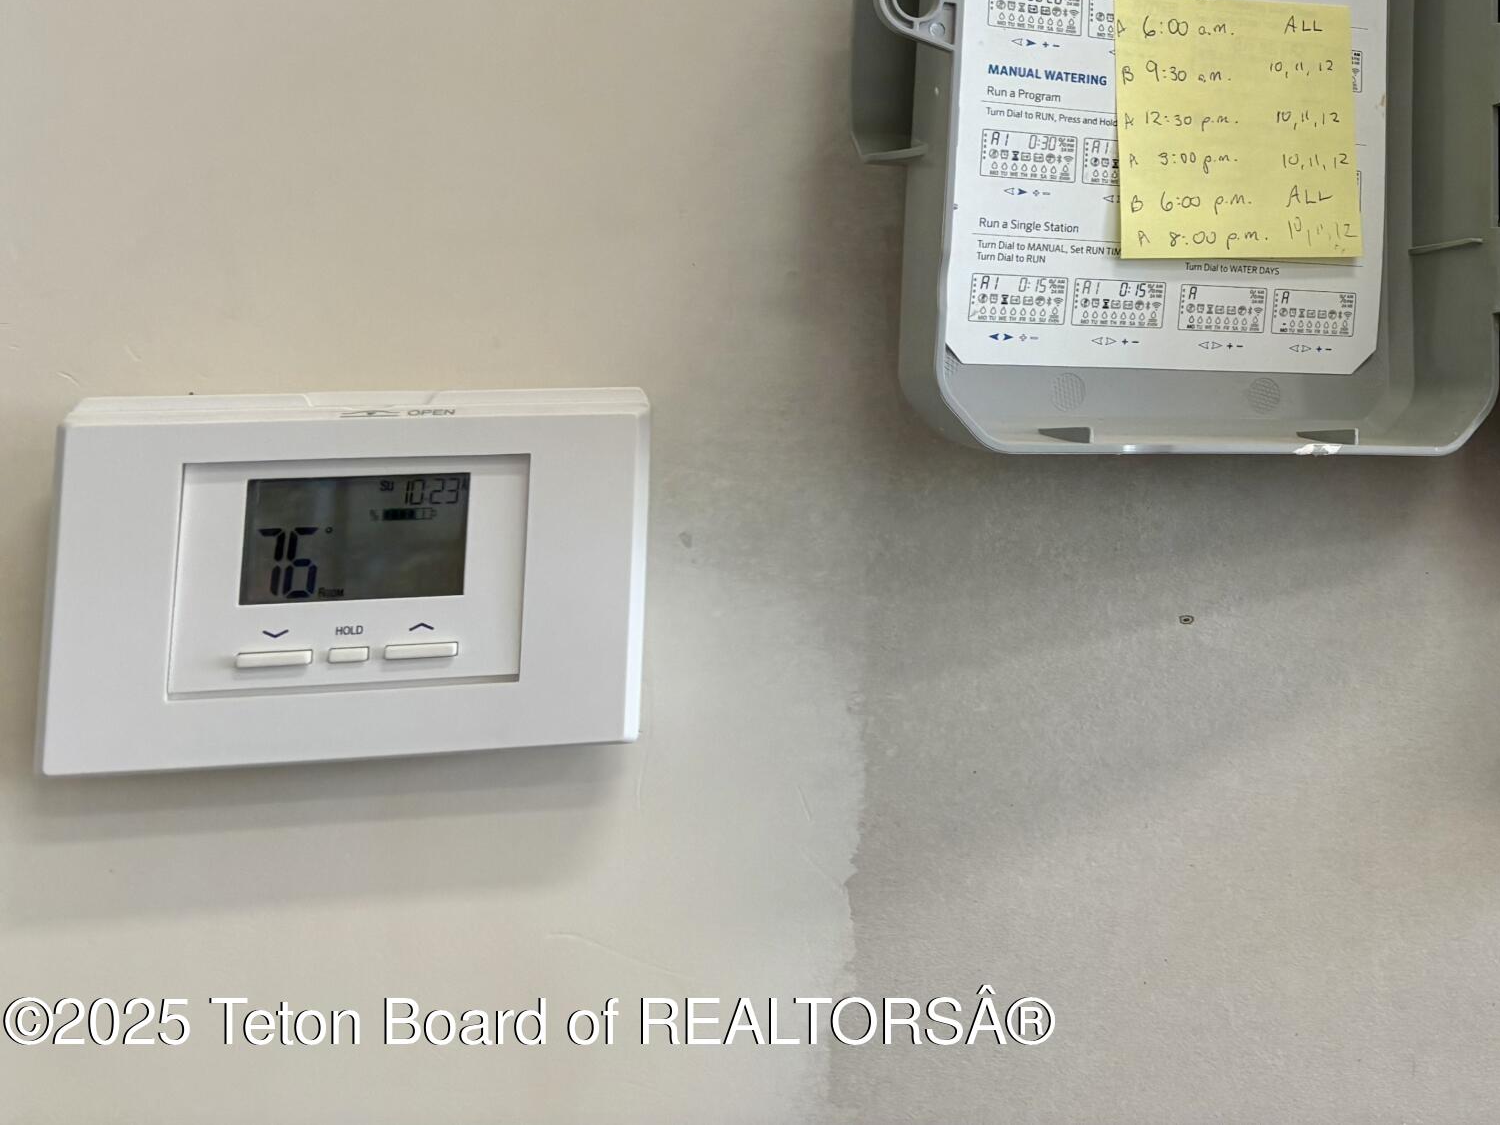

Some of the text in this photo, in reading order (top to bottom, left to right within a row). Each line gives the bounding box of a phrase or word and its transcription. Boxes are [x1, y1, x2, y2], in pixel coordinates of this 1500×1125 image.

[1142, 15, 1323, 39] 6:00 a.m. ALL
[988, 64, 1107, 86] MANUAL WATERING
[1121, 60, 1188, 85] B 9:30
[987, 86, 1007, 97] Run
[1018, 89, 1060, 103] Program
[986, 107, 1004, 116] Turn
[1006, 109, 1022, 118] Dial
[1035, 112, 1057, 122] RUN,
[1059, 114, 1080, 124] Press
[1082, 117, 1097, 125] and
[1124, 111, 1239, 132] A 12:30 p.m.
[1028, 134, 1057, 151] 0:30
[1158, 151, 1197, 166] 3:00
[1202, 154, 1238, 174] p.m.
[1131, 194, 1144, 213] B
[1160, 191, 1201, 212] 6:00
[1285, 184, 1333, 208] ALL
[979, 218, 1000, 229] Run
[1010, 219, 1041, 233] Single
[1043, 222, 1079, 233] Station
[977, 240, 996, 250] Turn
[998, 241, 1015, 251] Dial
[1016, 243, 1025, 251] to
[1027, 242, 1068, 255] MANUAL,
[1070, 245, 1084, 255] Set
[1086, 246, 1104, 256] RUN
[1138, 230, 1268, 250] A 8:00 p.m.
[977, 252, 1046, 263] Turn Dial to RUN
[1185, 262, 1280, 275] Turn Dial to WATER DAYS
[1119, 282, 1146, 298] 0:15
[335, 626, 363, 636] HOLD
